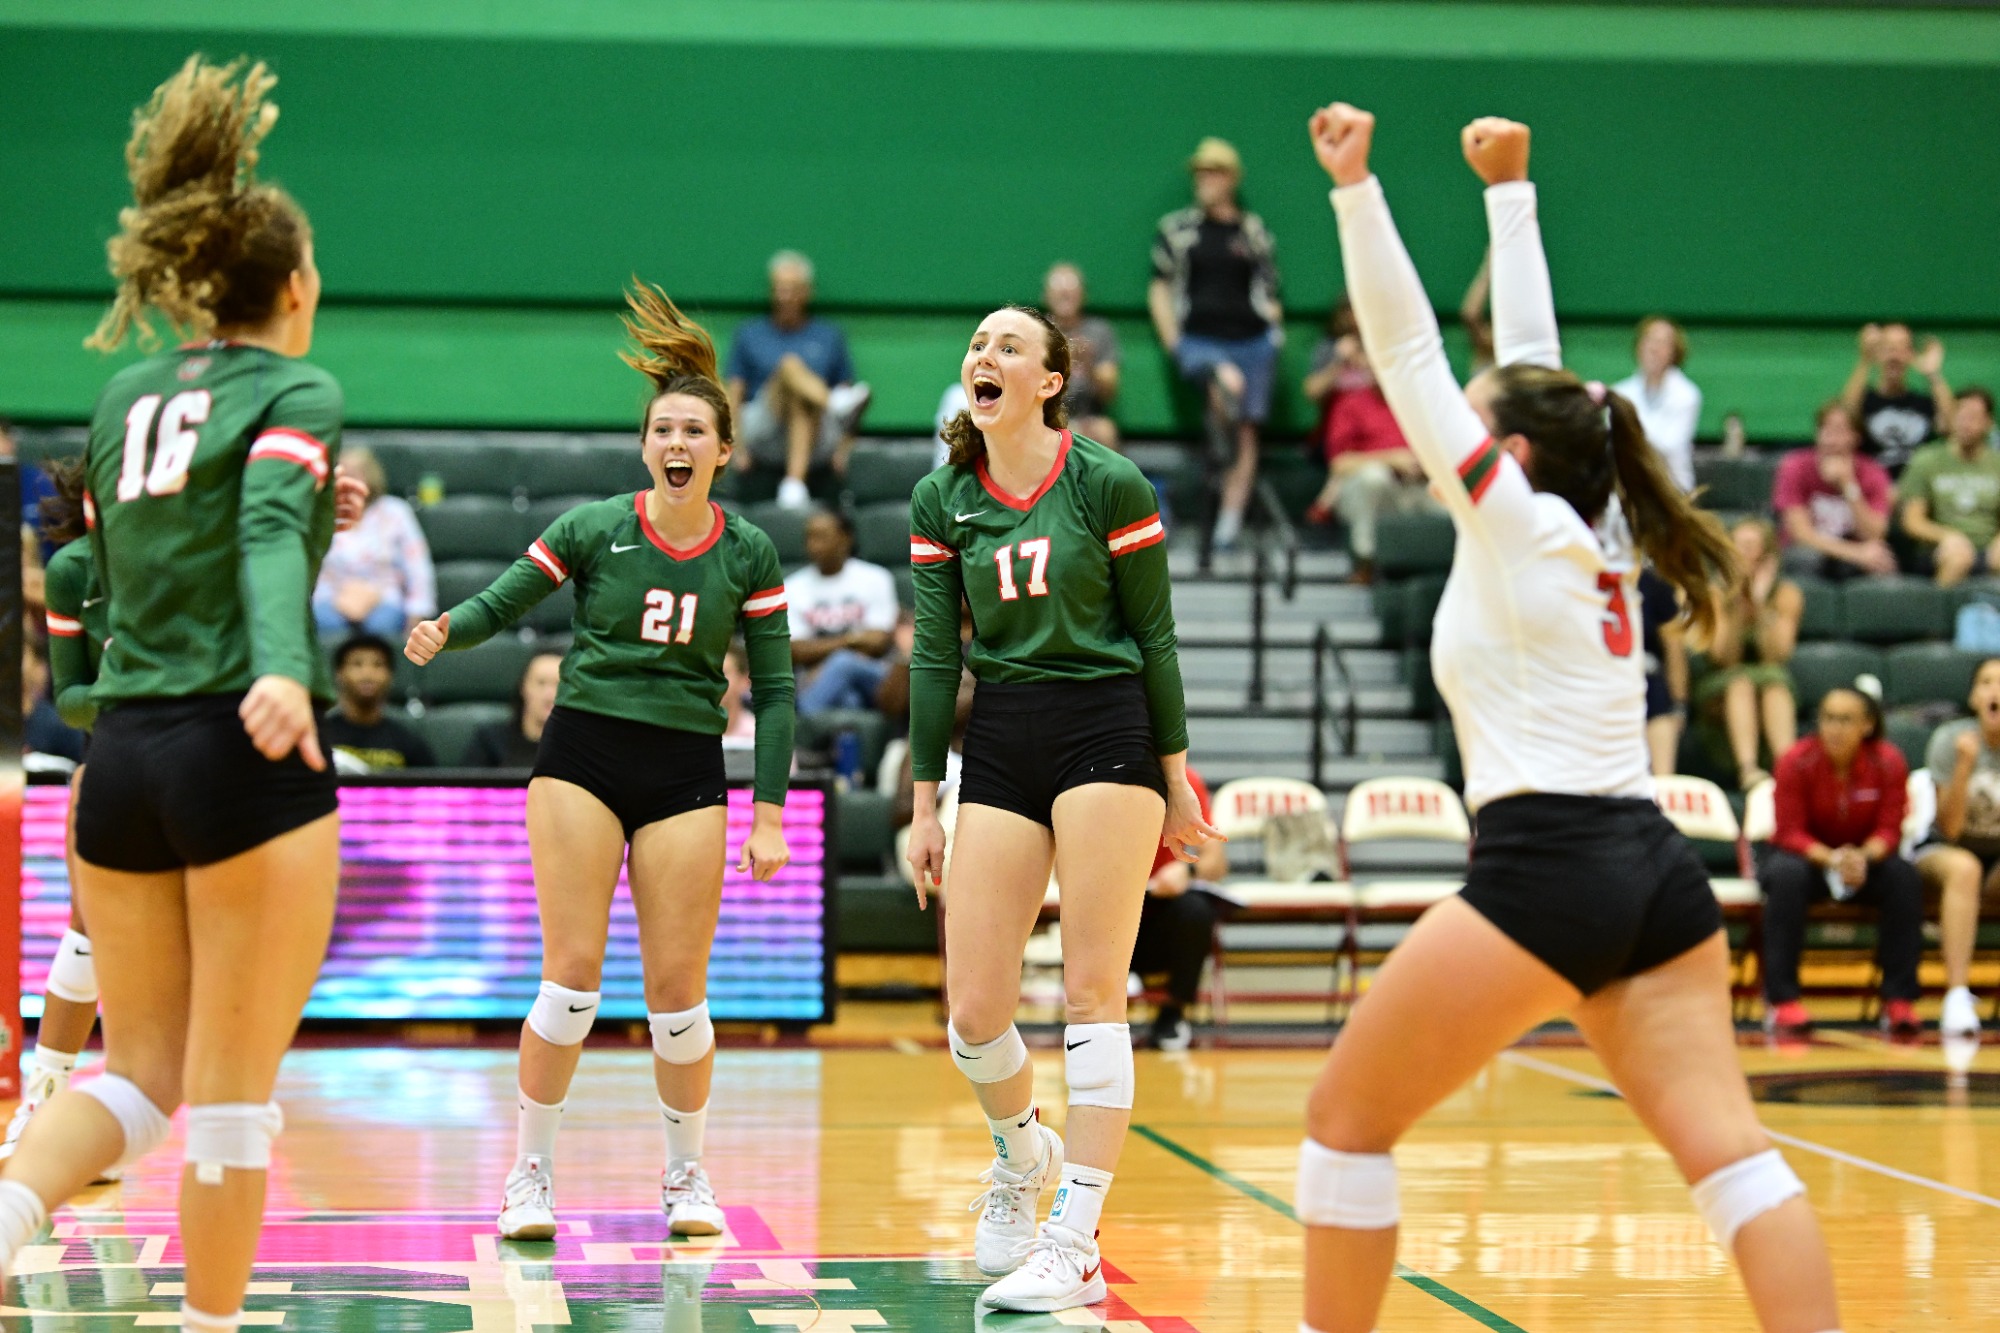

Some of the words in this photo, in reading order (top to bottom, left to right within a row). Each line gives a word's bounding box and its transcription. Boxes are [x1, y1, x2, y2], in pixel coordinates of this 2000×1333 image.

[117, 389, 211, 502] 16
[994, 536, 1050, 601] 17
[640, 588, 698, 645] 21
[1596, 572, 1632, 658] 3
